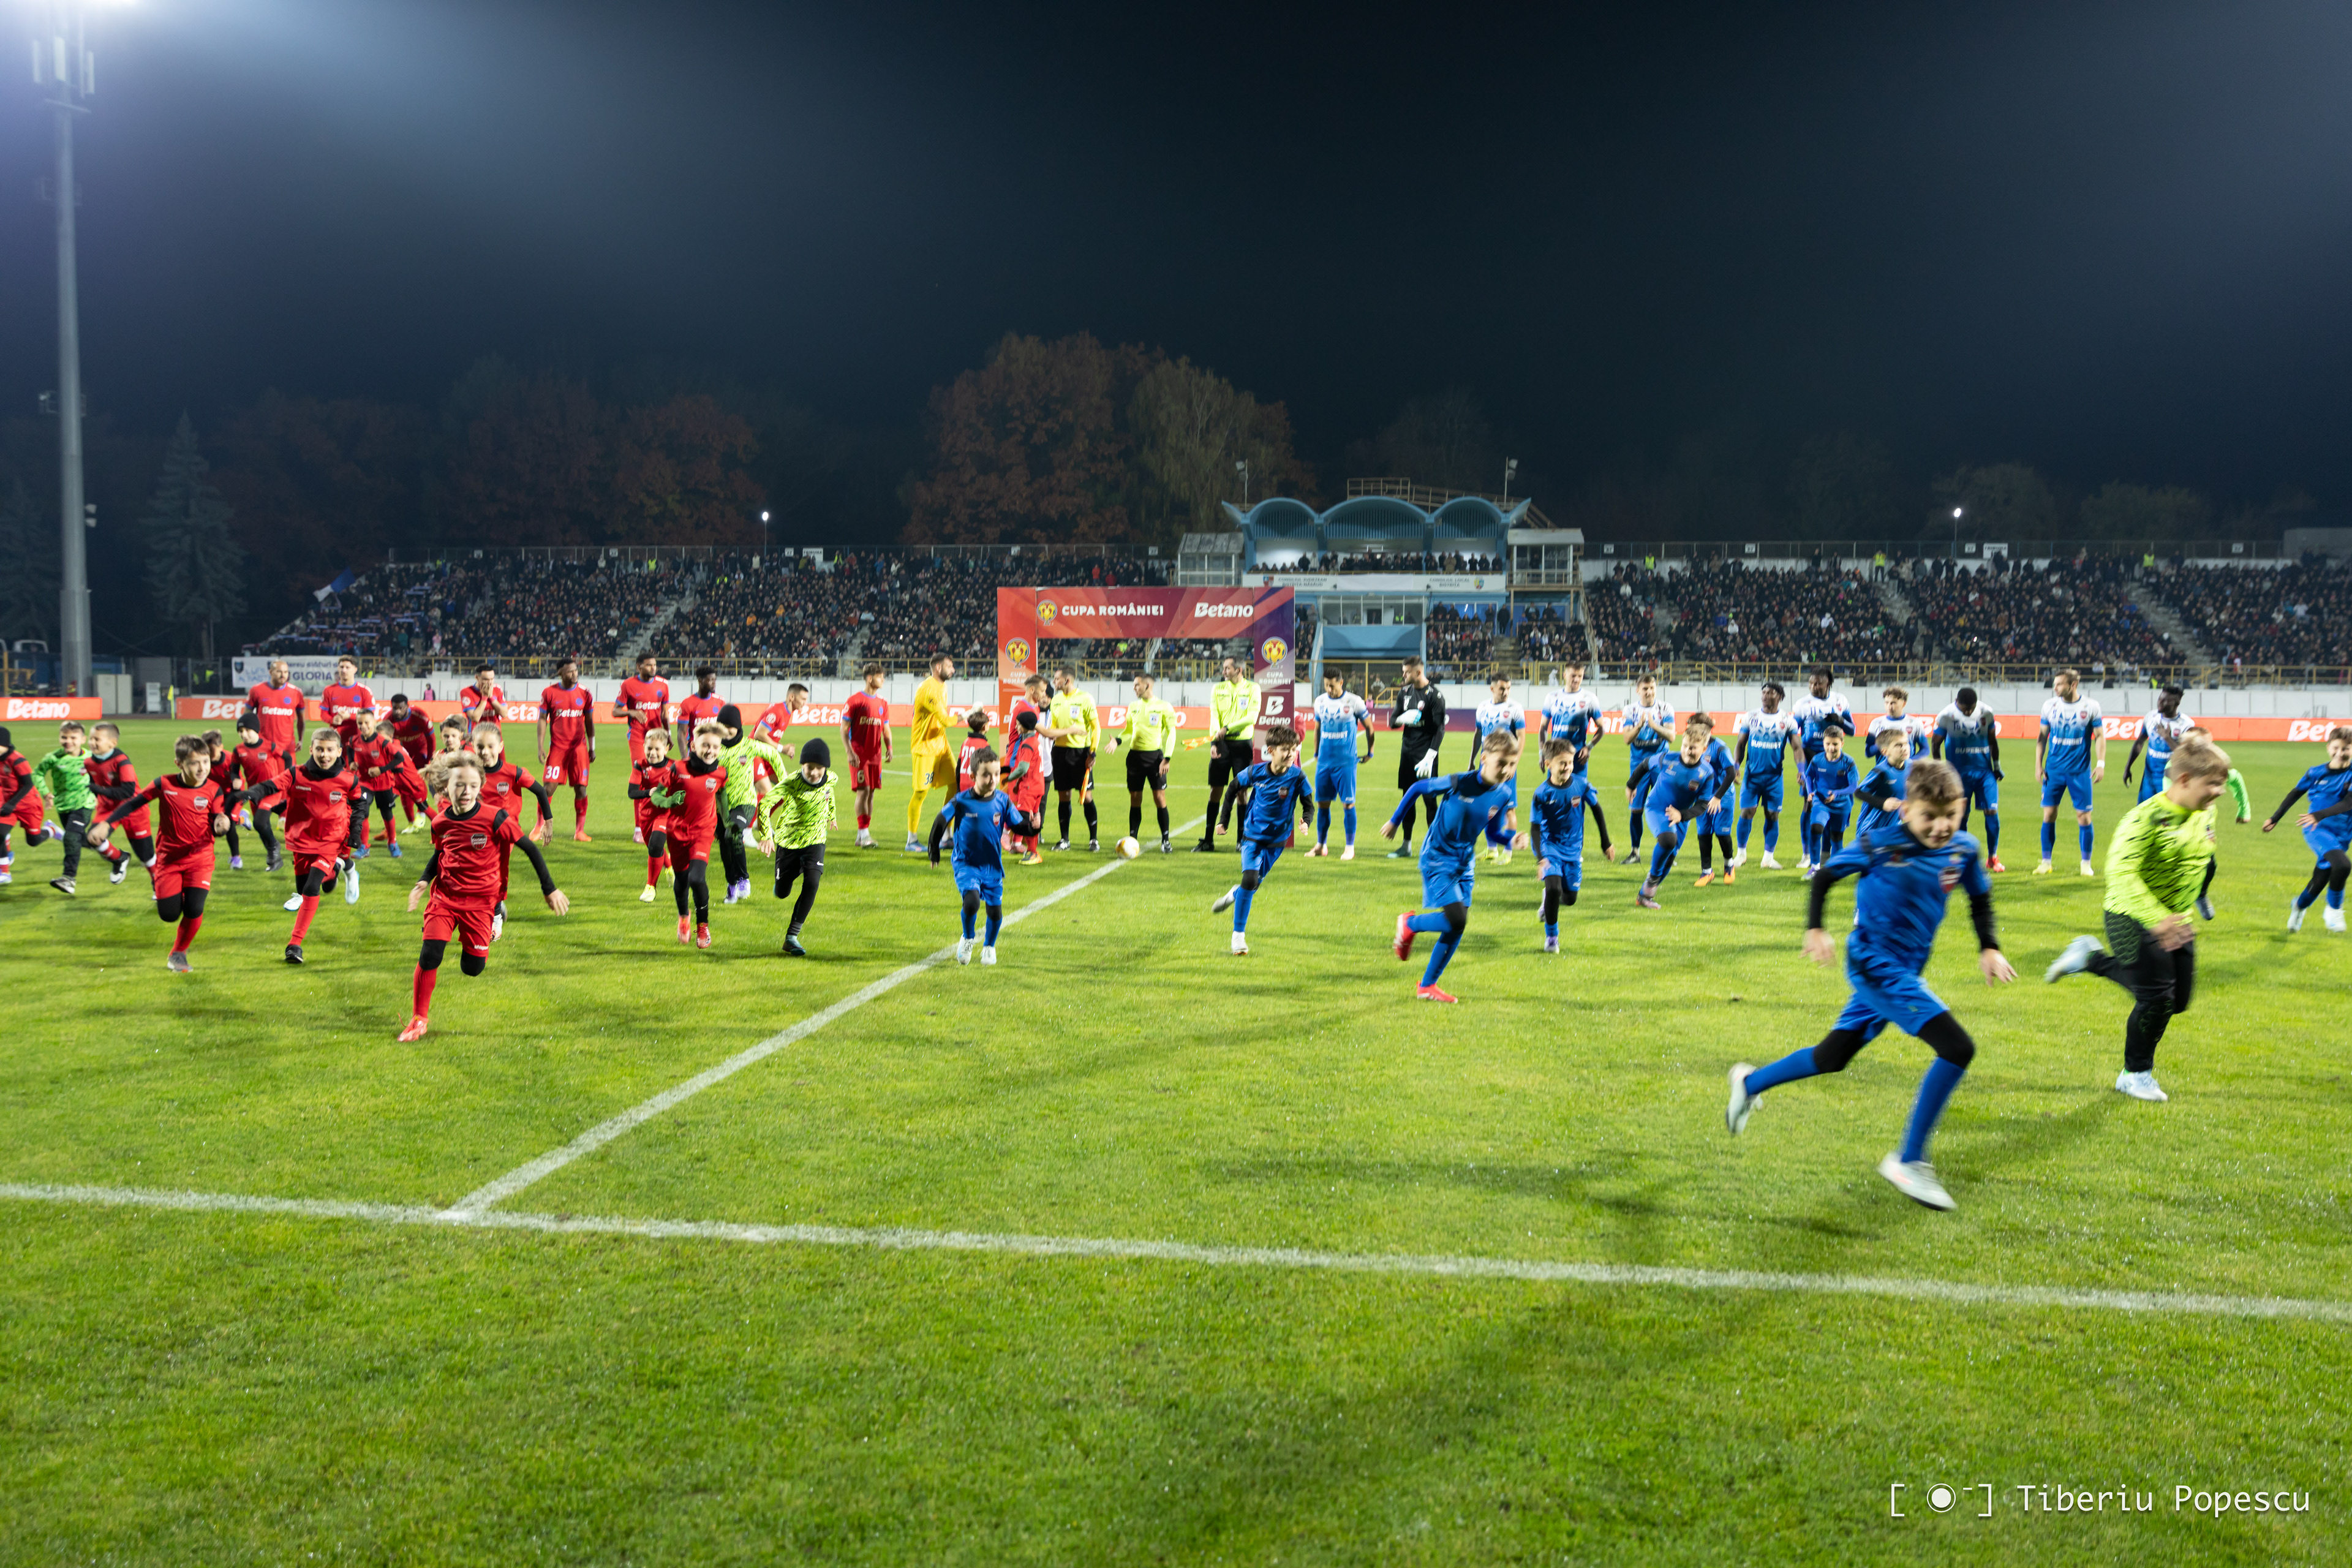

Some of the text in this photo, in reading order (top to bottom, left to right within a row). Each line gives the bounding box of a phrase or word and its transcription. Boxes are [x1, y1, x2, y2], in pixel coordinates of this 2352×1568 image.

[1061, 603, 1164, 616] CUPA ROMÂNIEI
[1194, 602, 1254, 617] Betano
[292, 671, 332, 681] GLORIA
[6, 699, 70, 719] Betano
[262, 706, 293, 716] Betano
[556, 708, 584, 718] Betano
[1259, 716, 1291, 726] Betano
[545, 766, 560, 780] 30
[757, 763, 766, 775] 4
[858, 769, 865, 783] 6
[924, 772, 934, 785] 38
